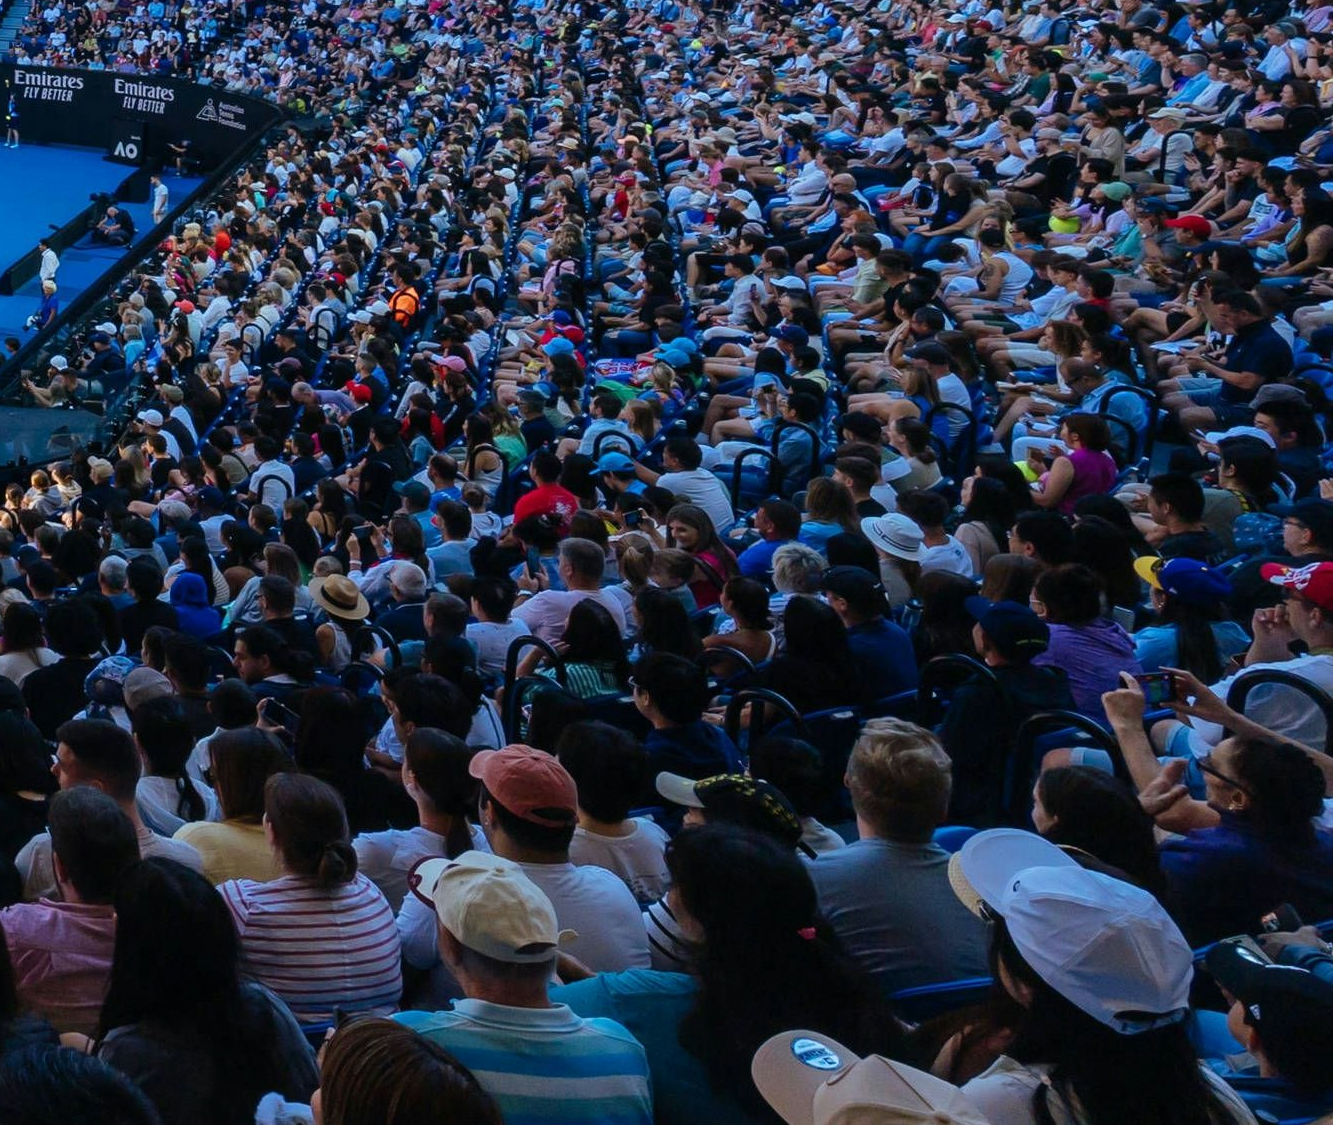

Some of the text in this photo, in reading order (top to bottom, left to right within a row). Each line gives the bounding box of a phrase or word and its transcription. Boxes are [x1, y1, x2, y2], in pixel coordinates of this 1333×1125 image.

[14, 69, 84, 90] Emirates
[23, 86, 73, 102] FLY BETTER
[114, 78, 175, 102] Emirates
[123, 95, 166, 115] FLY BETTER
[114, 141, 138, 159] AO
